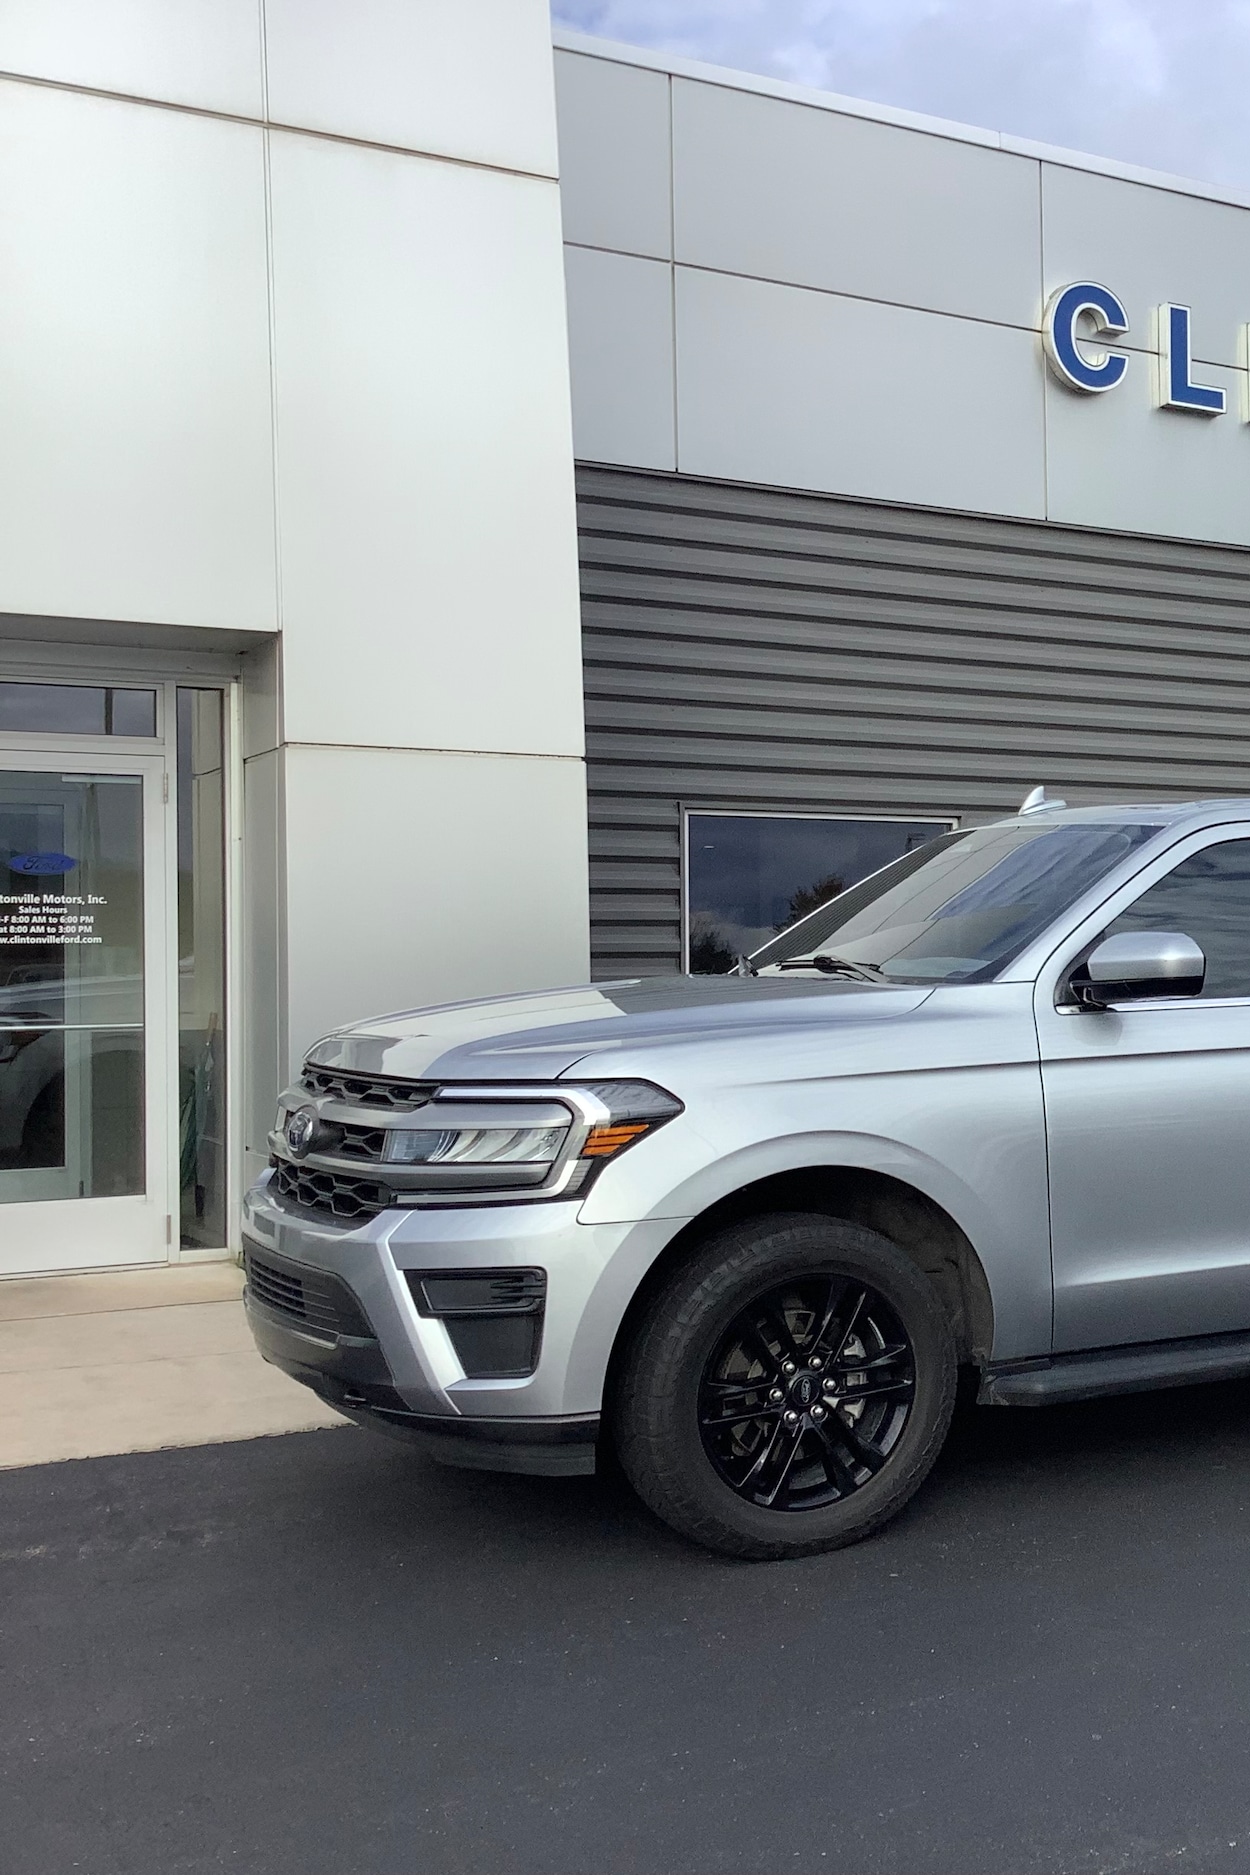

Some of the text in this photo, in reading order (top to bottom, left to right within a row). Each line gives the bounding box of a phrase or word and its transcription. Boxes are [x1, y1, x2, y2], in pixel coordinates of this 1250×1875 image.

[42, 894, 85, 905] Motors,
[87, 894, 108, 904] Inc.
[18, 905, 68, 914] Sales Hours
[10, 915, 30, 923] 8:00
[31, 915, 47, 923] AM
[60, 915, 78, 923] 6:00
[79, 915, 94, 923] PM
[9, 925, 28, 933] 8:00
[29, 925, 45, 933] AM
[57, 925, 77, 933] 3:00
[78, 925, 93, 933] PM
